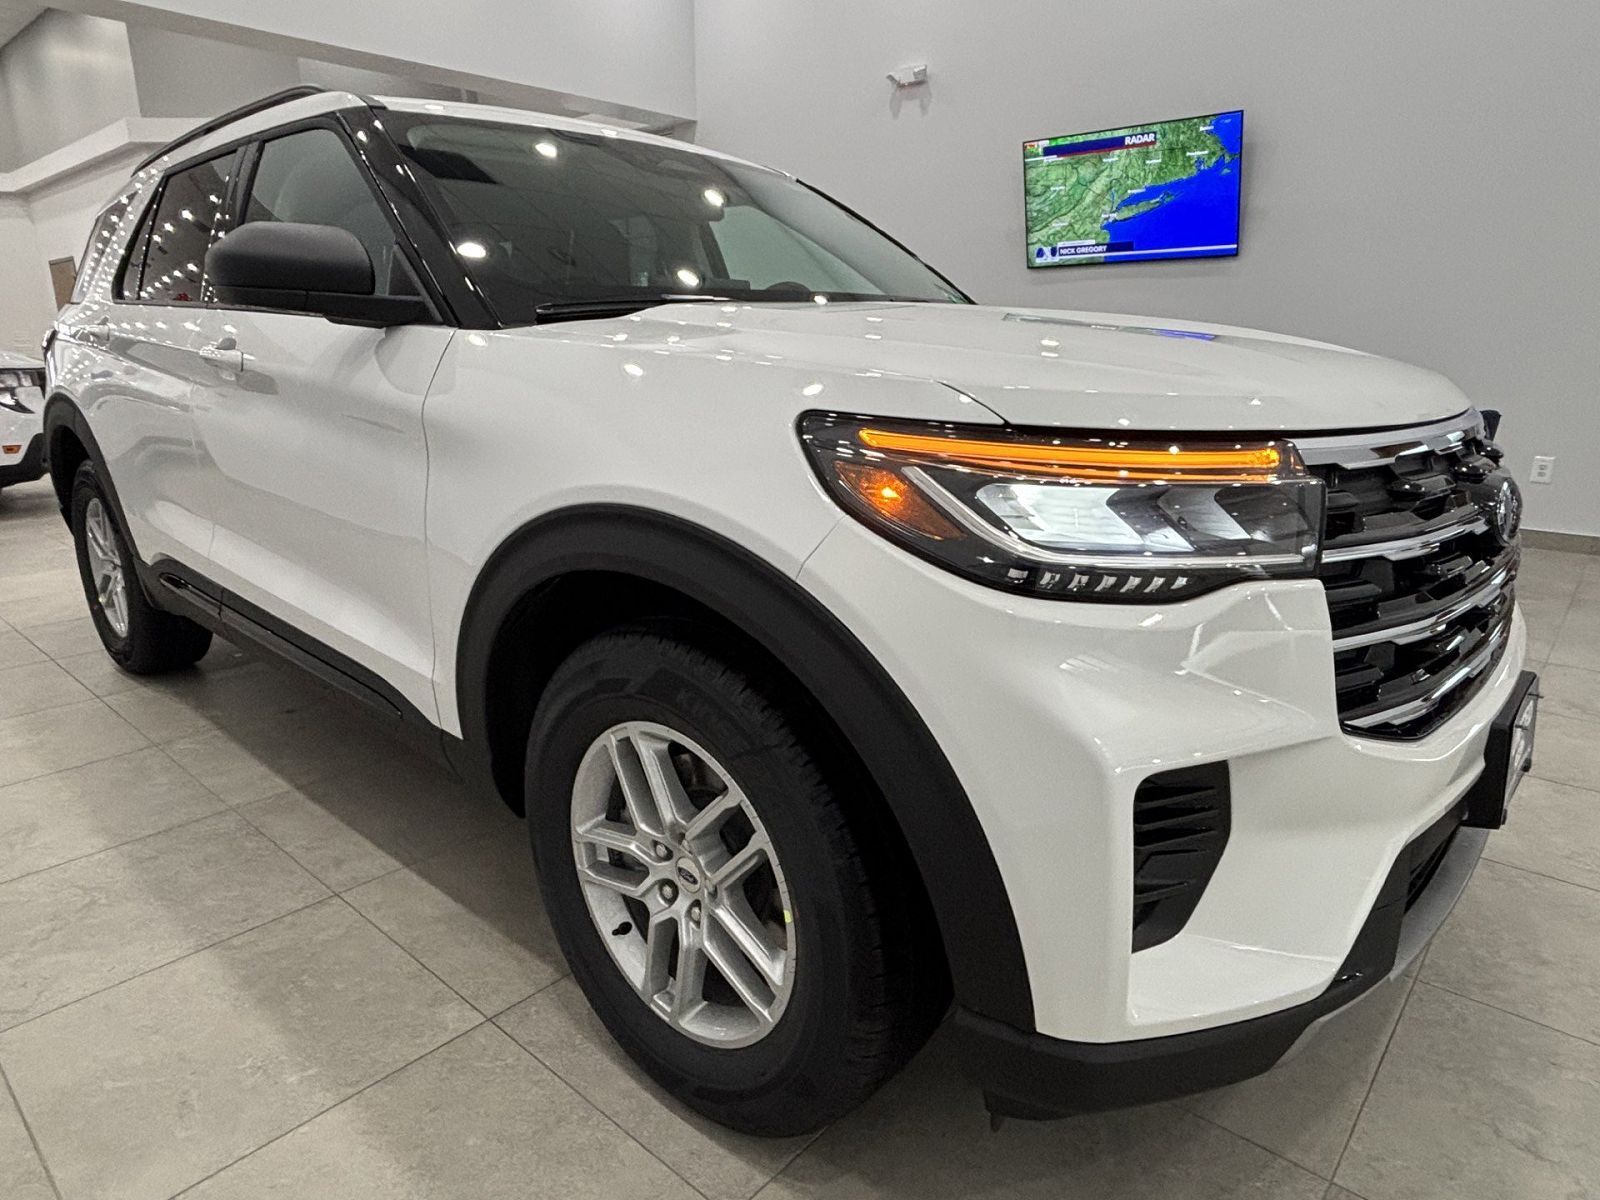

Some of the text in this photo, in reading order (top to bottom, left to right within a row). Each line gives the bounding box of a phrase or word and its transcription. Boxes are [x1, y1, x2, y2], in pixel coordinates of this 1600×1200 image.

[1125, 133, 1155, 145] RADAR
[1060, 245, 1108, 255] NICK GREGORY
